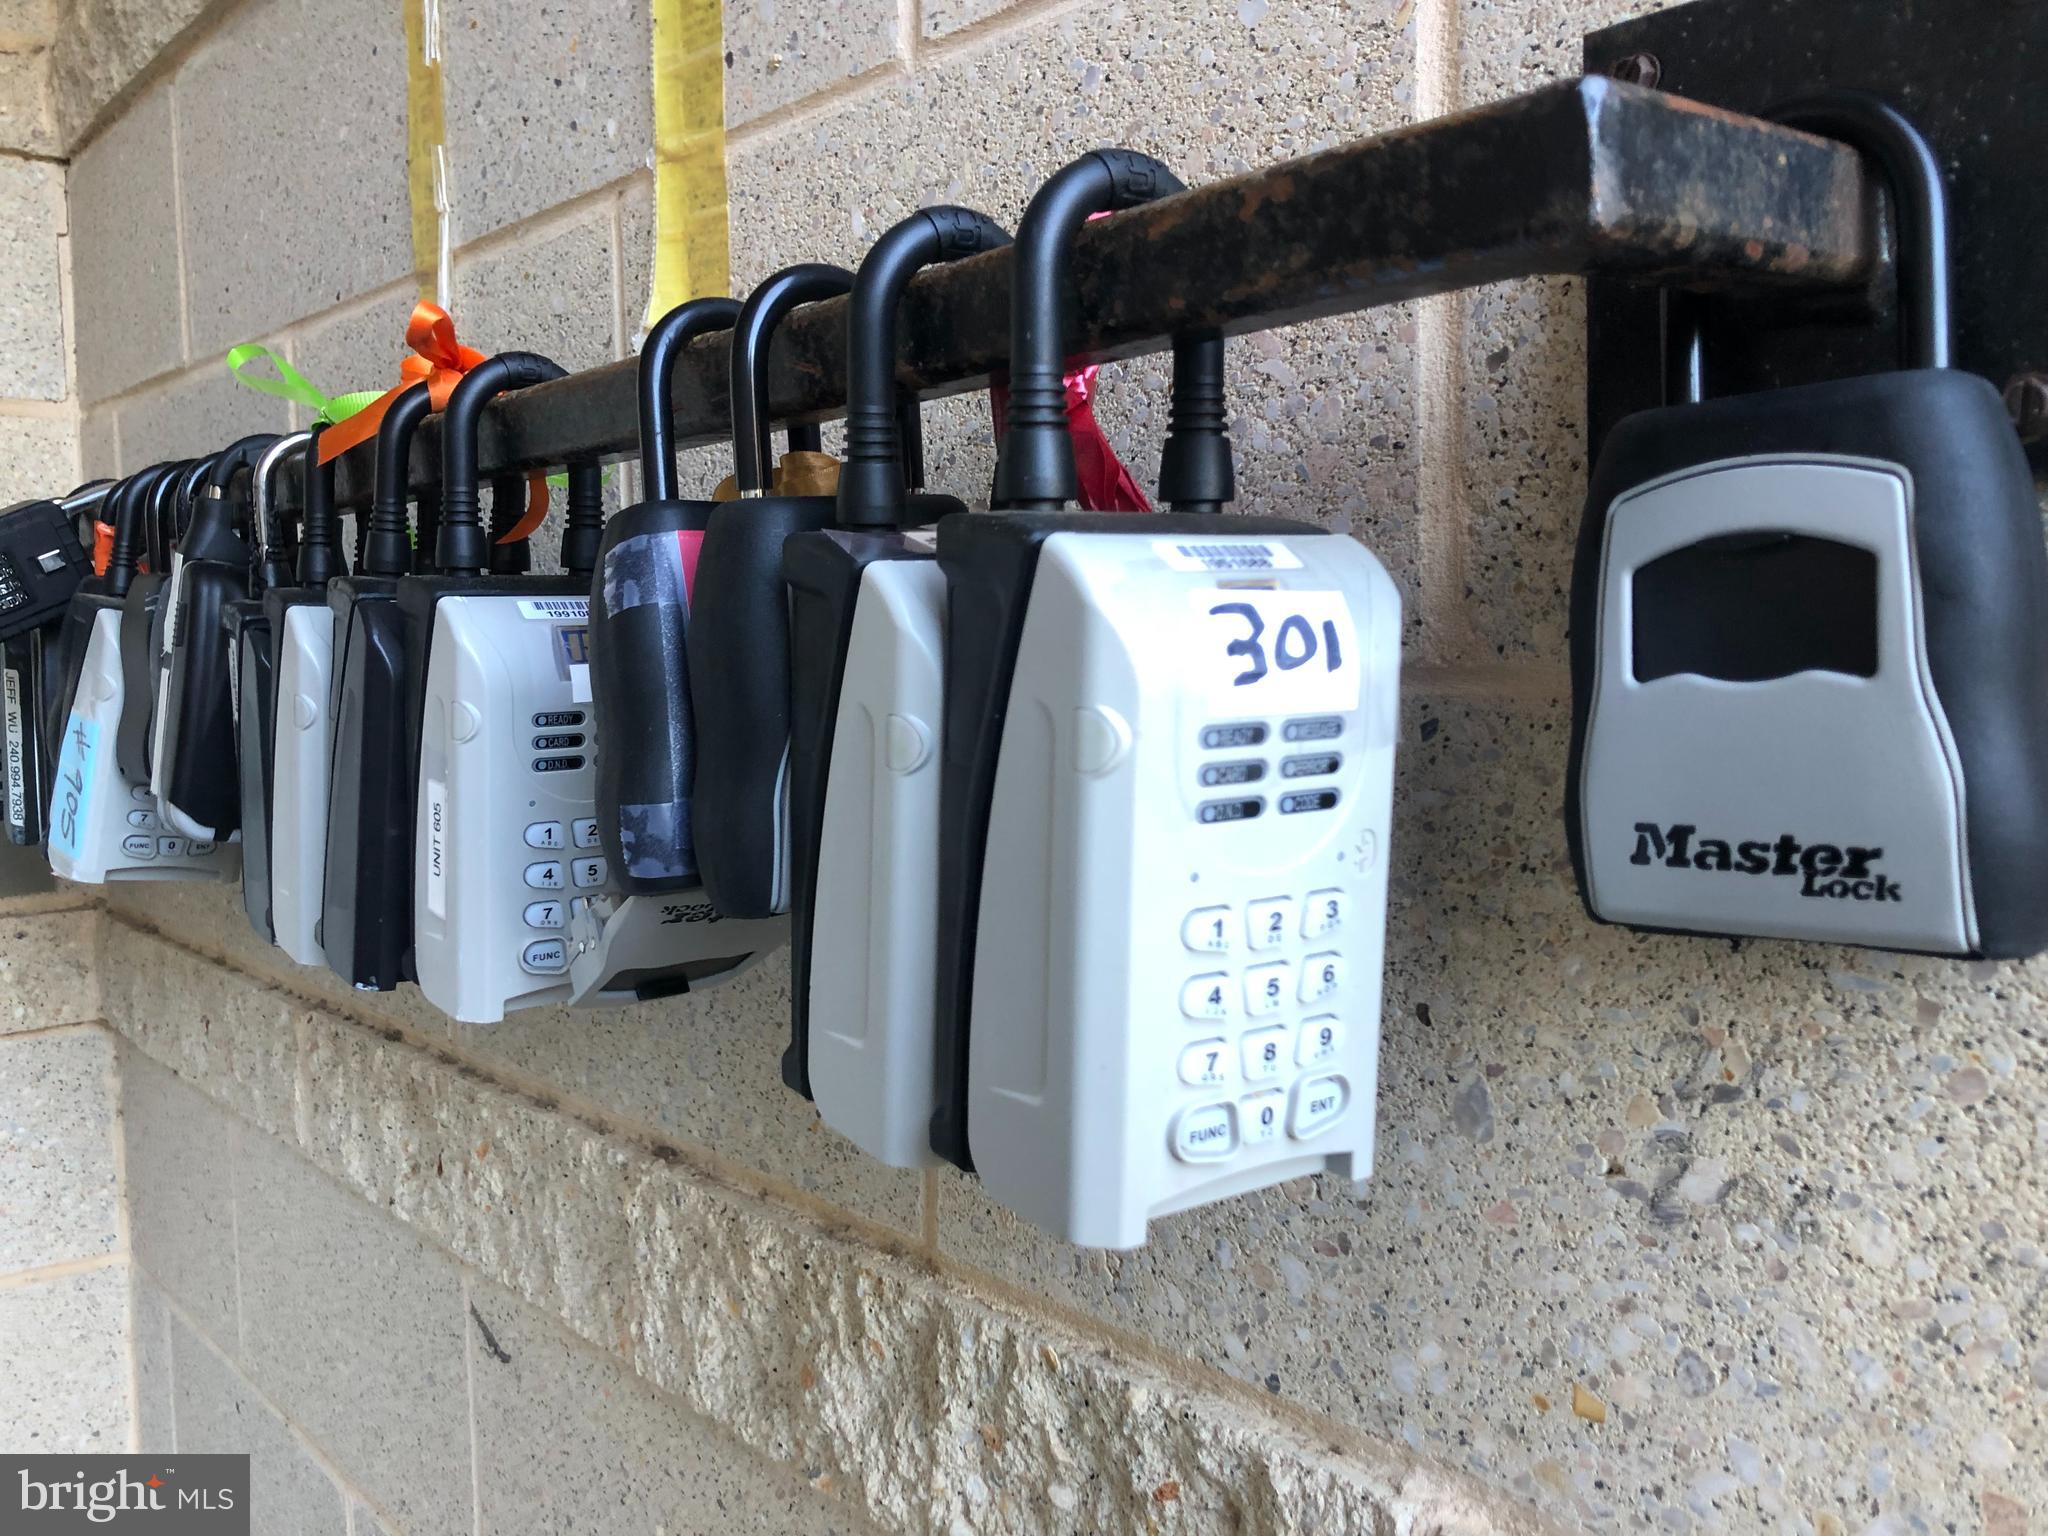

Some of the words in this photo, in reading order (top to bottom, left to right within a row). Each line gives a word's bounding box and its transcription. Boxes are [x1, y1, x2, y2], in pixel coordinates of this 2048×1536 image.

[1209, 602, 1342, 686] 301
[5, 672, 17, 704] JEFF
[548, 714, 574, 724] READY
[548, 737, 569, 747] CARD
[8, 741, 24, 821] 240.994.7938
[61, 768, 83, 849] 905
[433, 802, 442, 832] 605
[545, 828, 552, 840] 1
[588, 824, 598, 836] 2
[433, 835, 441, 877] UNIT
[1630, 822, 1883, 878] Master
[543, 868, 554, 880] 4
[588, 864, 598, 876] 5
[1800, 872, 1902, 901] Lock
[543, 907, 553, 919] 7
[1212, 918, 1223, 938] 1
[1268, 911, 1283, 932] 2
[1326, 900, 1339, 919] 3
[532, 950, 561, 962] FUNC
[1208, 986, 1222, 1004] 4
[1266, 977, 1280, 997] 5
[1323, 964, 1335, 982] 6
[1206, 1051, 1219, 1072] 7
[1264, 1042, 1276, 1061] 8
[1320, 1027, 1332, 1046] 9
[1190, 1124, 1227, 1144] FUNC
[1261, 1106, 1273, 1126] 0
[1310, 1096, 1335, 1113] ENT
